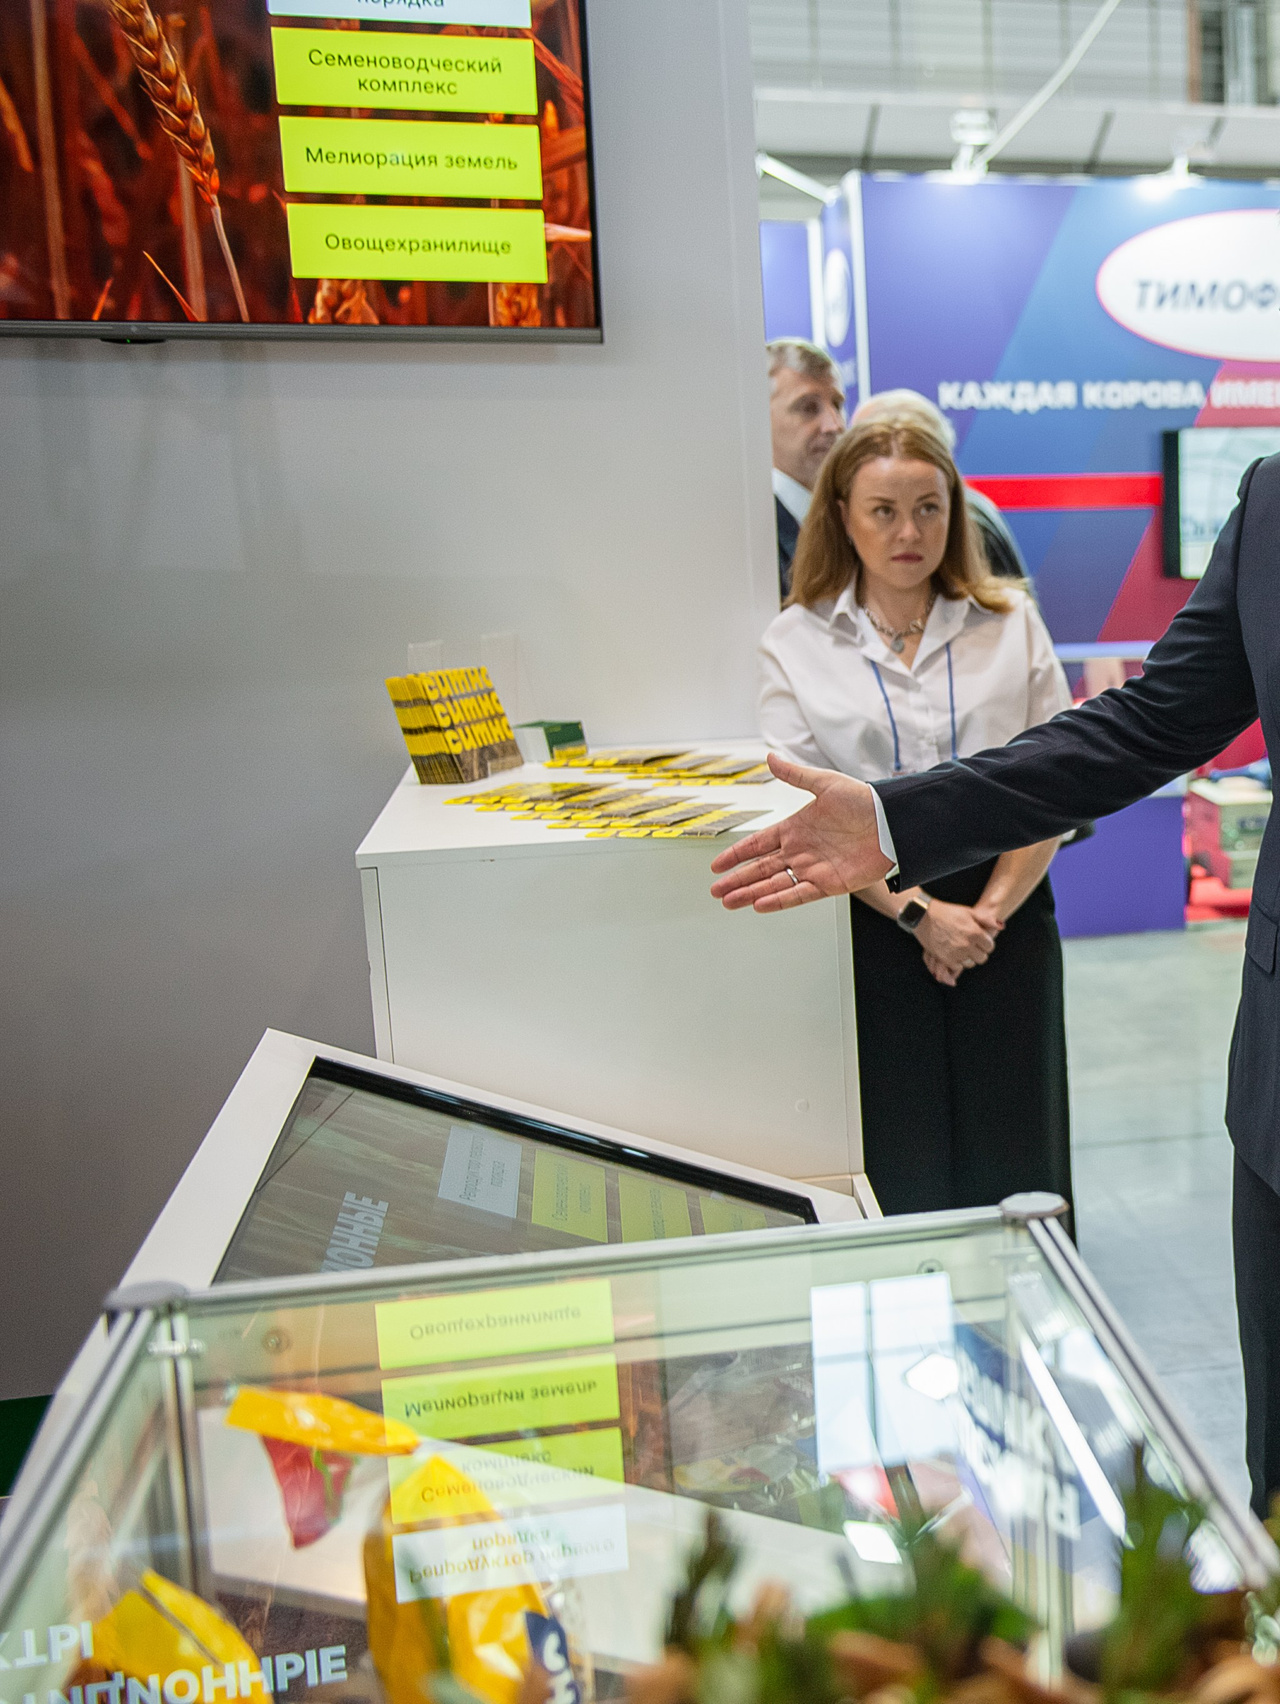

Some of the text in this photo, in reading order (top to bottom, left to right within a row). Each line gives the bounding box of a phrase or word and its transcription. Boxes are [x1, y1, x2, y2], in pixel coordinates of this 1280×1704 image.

[308, 48, 502, 74] Семеноводческий
[358, 78, 458, 96] комплекс
[305, 147, 518, 171] Мелиорация земель
[325, 233, 512, 256] Овощехранилище
[938, 381, 1078, 414] КАЖДАЯ
[1082, 382, 1206, 410] КОРОВА
